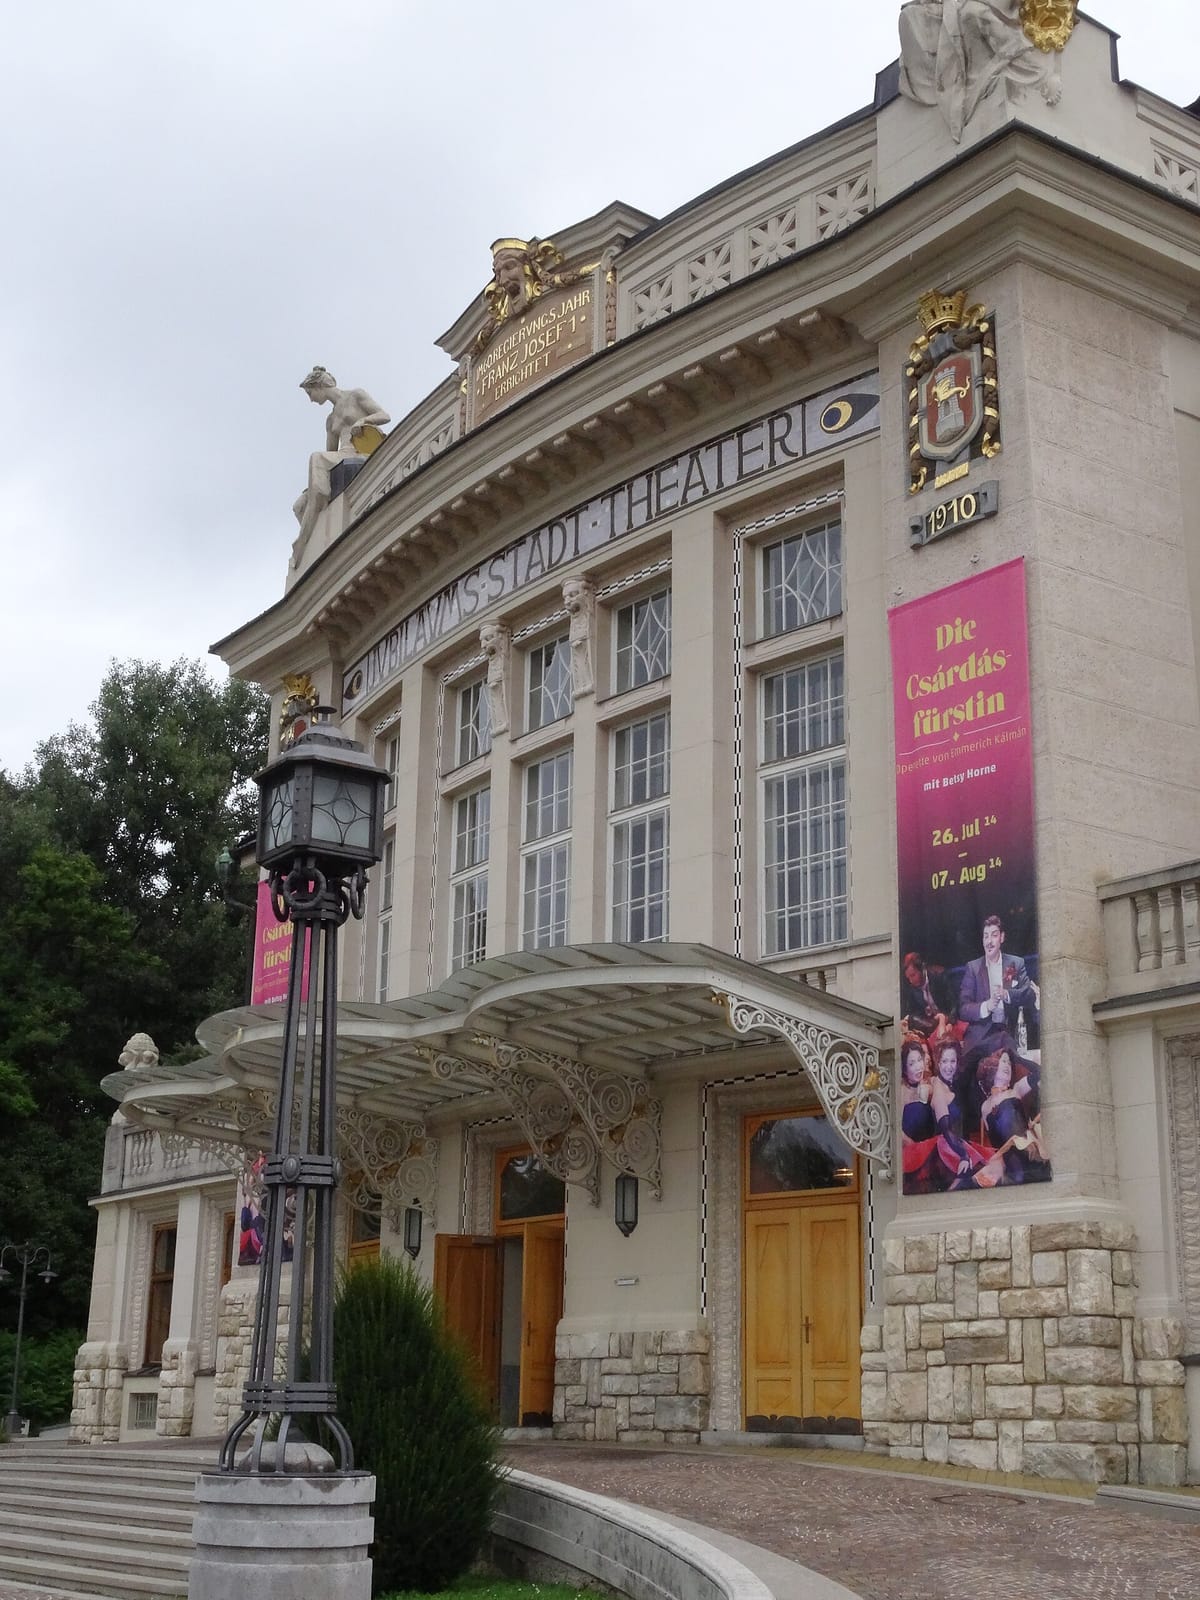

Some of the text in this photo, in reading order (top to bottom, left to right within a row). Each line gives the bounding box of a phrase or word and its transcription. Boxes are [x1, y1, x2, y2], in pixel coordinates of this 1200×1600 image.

[481, 351, 519, 396] FRANZ
[521, 320, 567, 364] JOSEF
[601, 412, 798, 538] THEATER
[928, 493, 976, 535] 1910
[936, 617, 976, 651] Die
[913, 690, 1005, 738] fürstin
[932, 751, 950, 763] von
[950, 737, 992, 760] Emmerich
[923, 763, 997, 792] mit Betsy Horne
[932, 827, 959, 847] 26.
[984, 814, 998, 826] 14
[931, 856, 1002, 890] 07. Aug 14
